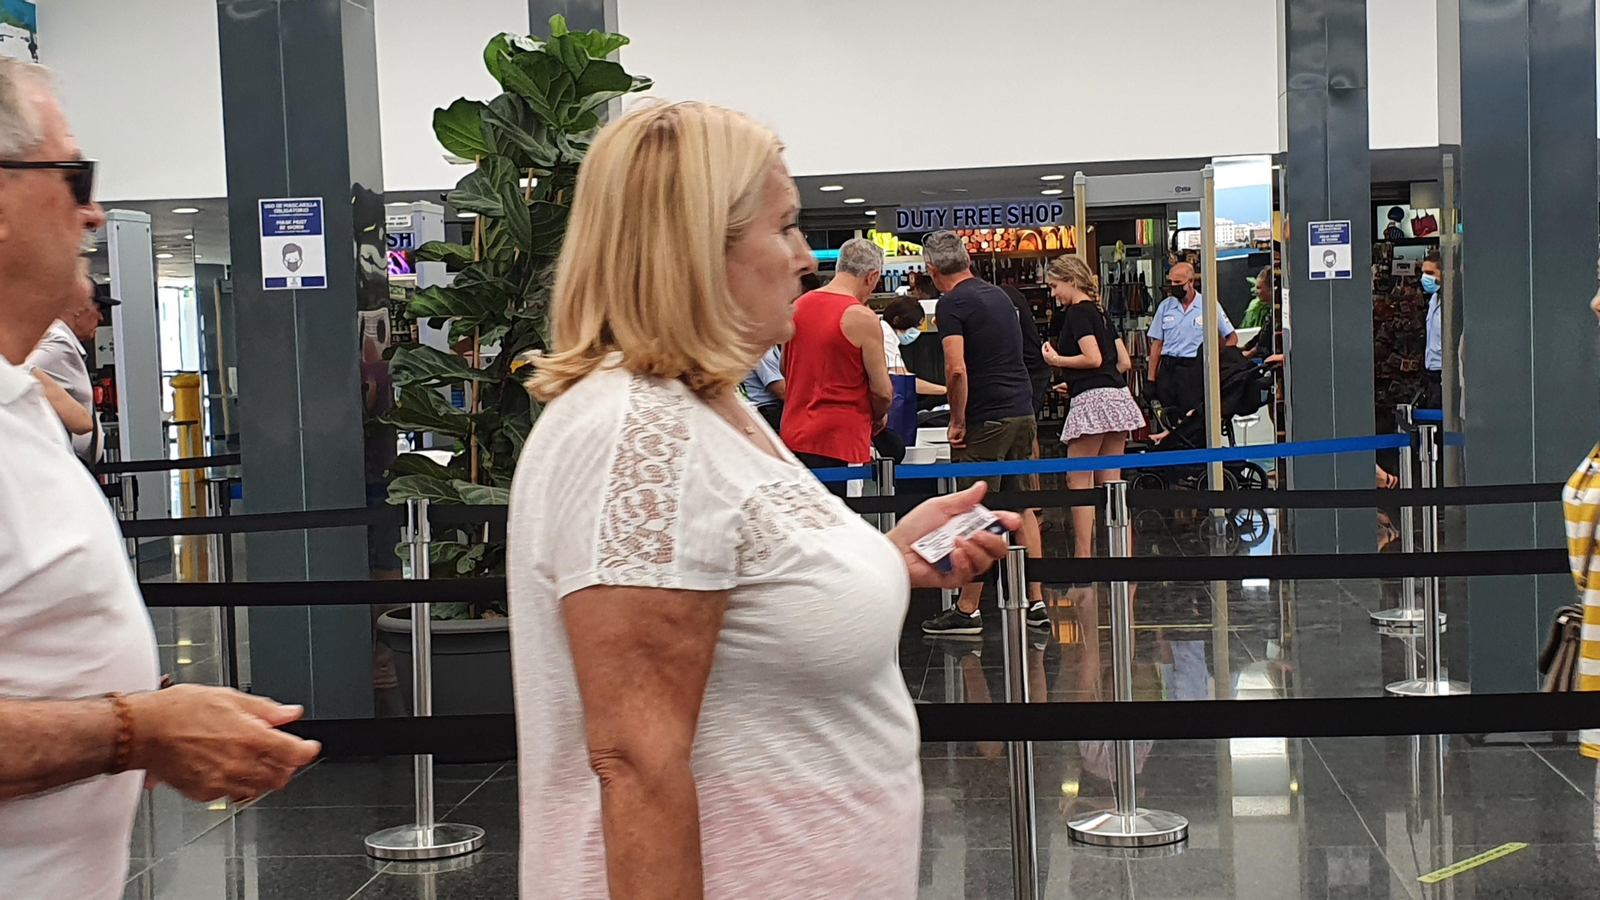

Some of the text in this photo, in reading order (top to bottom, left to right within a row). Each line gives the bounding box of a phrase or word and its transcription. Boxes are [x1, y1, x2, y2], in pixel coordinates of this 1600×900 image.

[896, 204, 1063, 229] DUTY FREE SHOP
